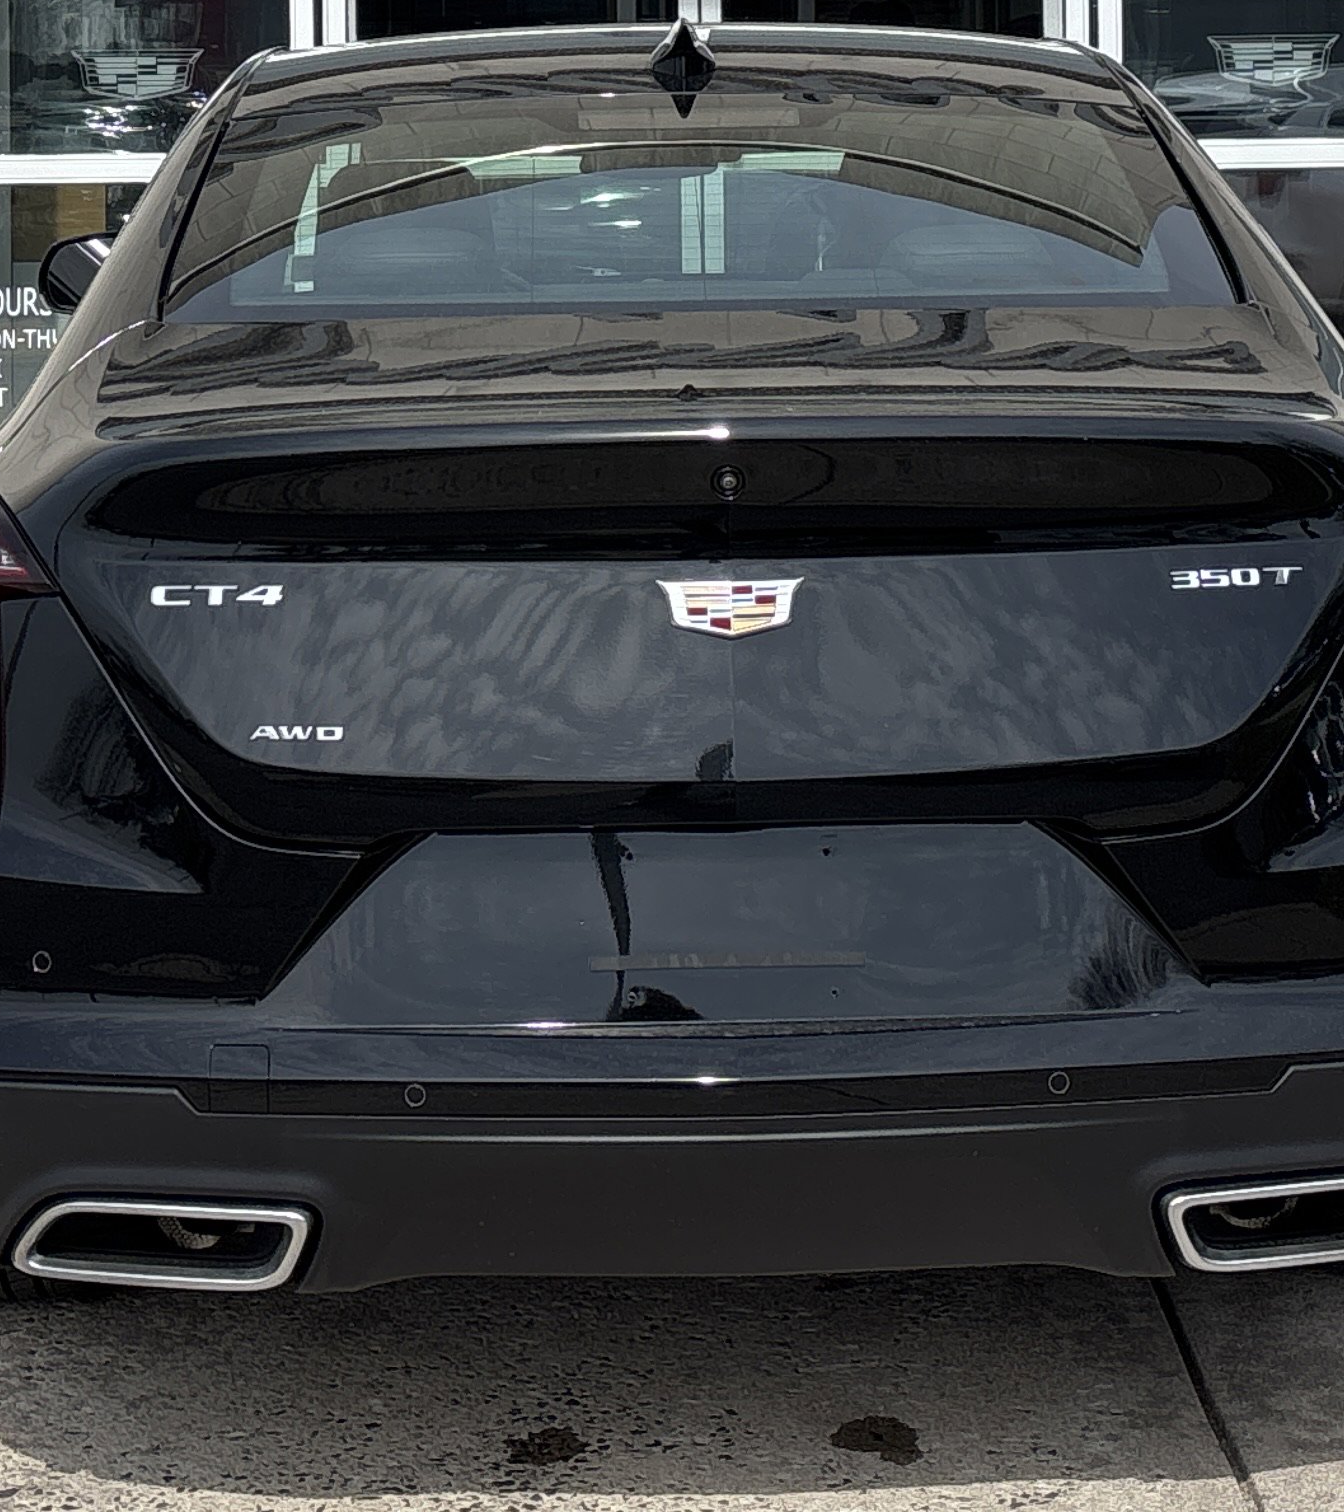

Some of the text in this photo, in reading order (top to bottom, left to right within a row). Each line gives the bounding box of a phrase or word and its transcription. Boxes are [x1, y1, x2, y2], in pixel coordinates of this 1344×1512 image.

[1169, 566, 1304, 590] 350T
[150, 584, 284, 606] CT4
[249, 725, 344, 741] AWD
